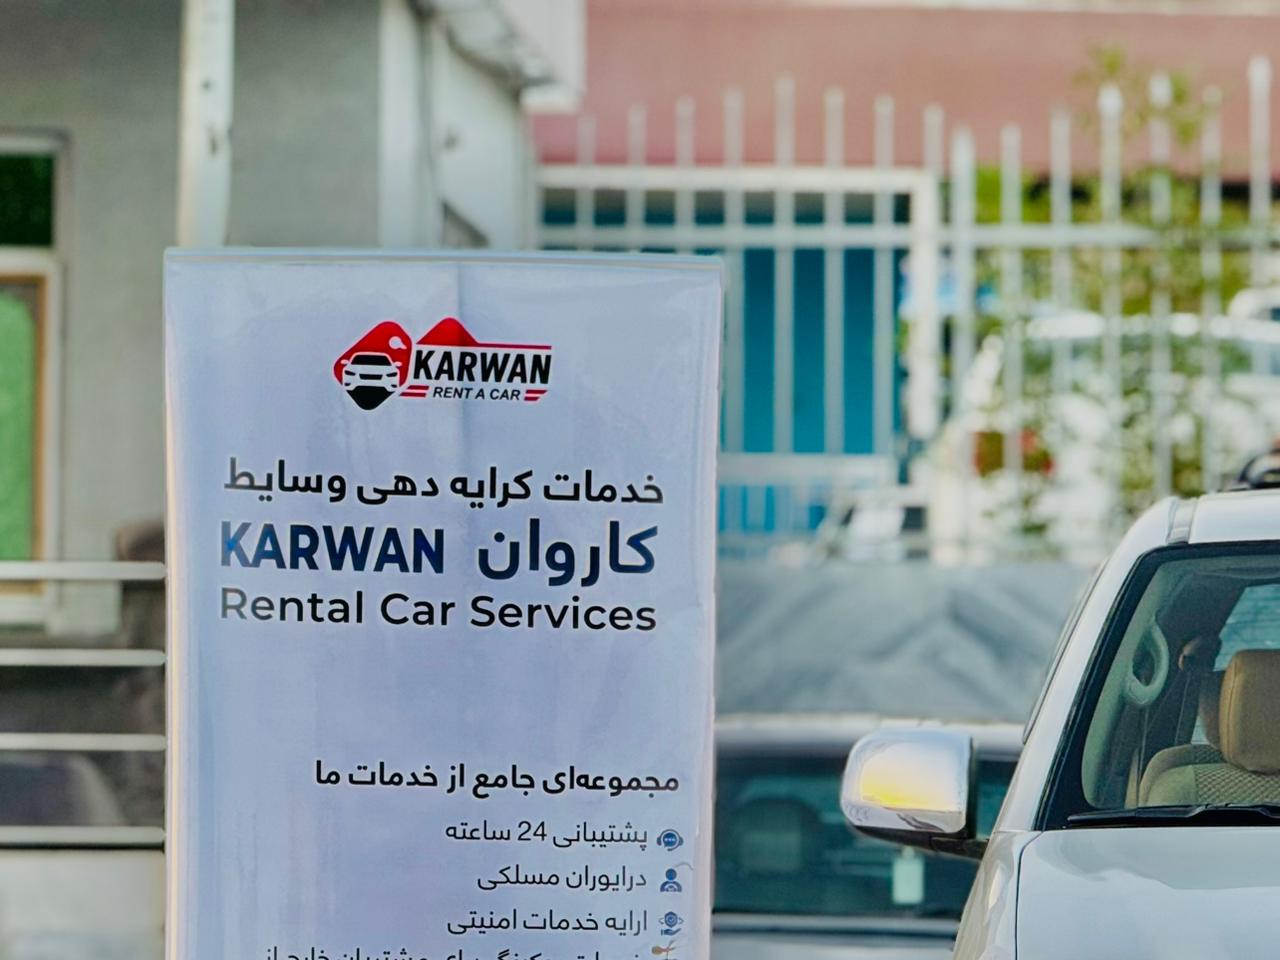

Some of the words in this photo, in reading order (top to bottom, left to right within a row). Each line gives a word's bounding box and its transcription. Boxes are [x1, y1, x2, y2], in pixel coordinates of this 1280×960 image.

[414, 349, 552, 385] KARWAN
[433, 386, 471, 400] RENT
[475, 388, 487, 400] A
[490, 388, 521, 401] CAR
[224, 456, 346, 503] وسایط
[357, 474, 439, 505] دهی
[450, 466, 533, 509] کرایه
[544, 469, 663, 504] خدمات
[221, 521, 445, 575] KARWAN
[478, 518, 658, 587] کاروان
[220, 587, 363, 625] Rental
[380, 592, 456, 627] Car
[470, 596, 657, 632] Services
[315, 760, 341, 785] ما
[348, 761, 438, 787] خدمات
[446, 763, 465, 794] از
[471, 764, 536, 799] جامع
[445, 820, 511, 841] ساعته
[517, 820, 548, 842] 24
[553, 821, 648, 851] پشتیبانی
[477, 865, 560, 891] مسلکی
[566, 866, 647, 892] درایوران
[447, 908, 517, 935] امنیتی
[522, 909, 599, 931] خدمات
[605, 910, 648, 937] ارایه
